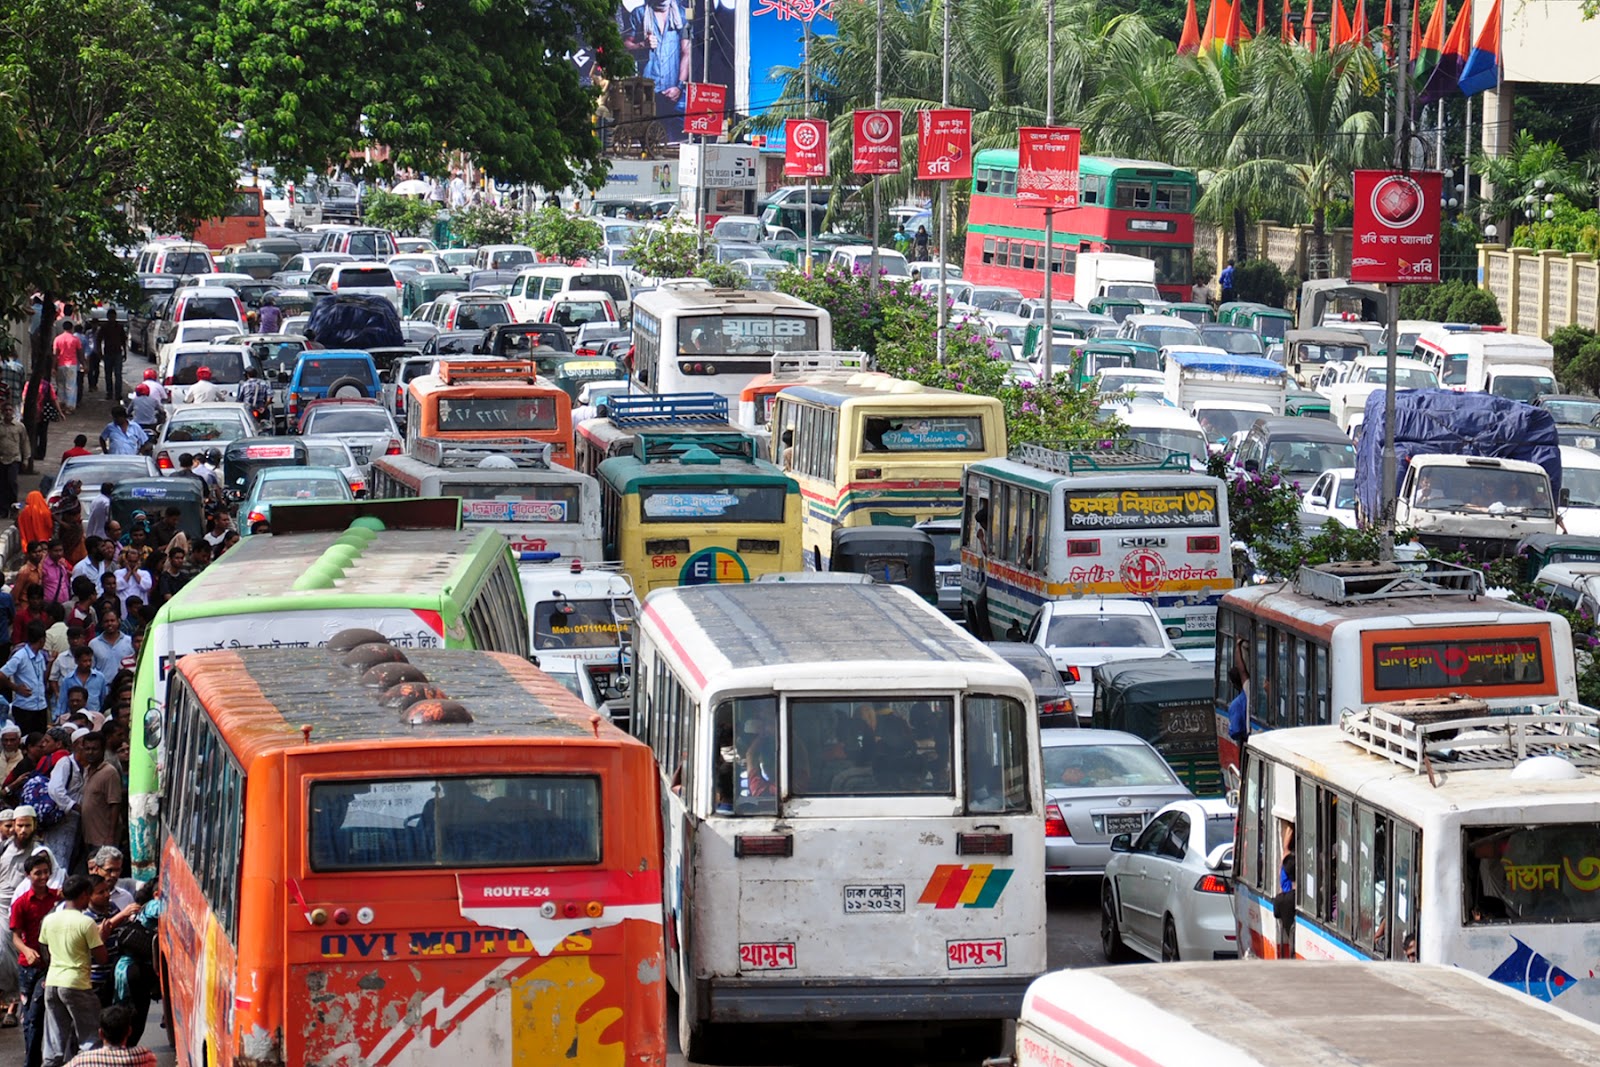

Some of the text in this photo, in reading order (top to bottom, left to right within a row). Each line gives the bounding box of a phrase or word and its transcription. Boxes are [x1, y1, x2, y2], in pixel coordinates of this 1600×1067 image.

[927, 156, 950, 175] রবি
[1361, 232, 1377, 244] রবি
[1380, 235, 1397, 244] জব
[1412, 258, 1432, 274] রবি
[1070, 498, 1119, 515] সময়
[1184, 490, 1215, 511] ৩৯
[1119, 537, 1168, 548] ISUZU
[652, 554, 678, 569] সিটি
[1167, 562, 1218, 581] গেটলক
[483, 887, 550, 898] ROUTE-24
[846, 888, 867, 898] ঢাকা
[847, 900, 902, 909] ১১-২০২২
[321, 928, 593, 957] OVI MOTOS
[740, 943, 794, 968] থামুন
[948, 941, 1003, 965] থামুন
